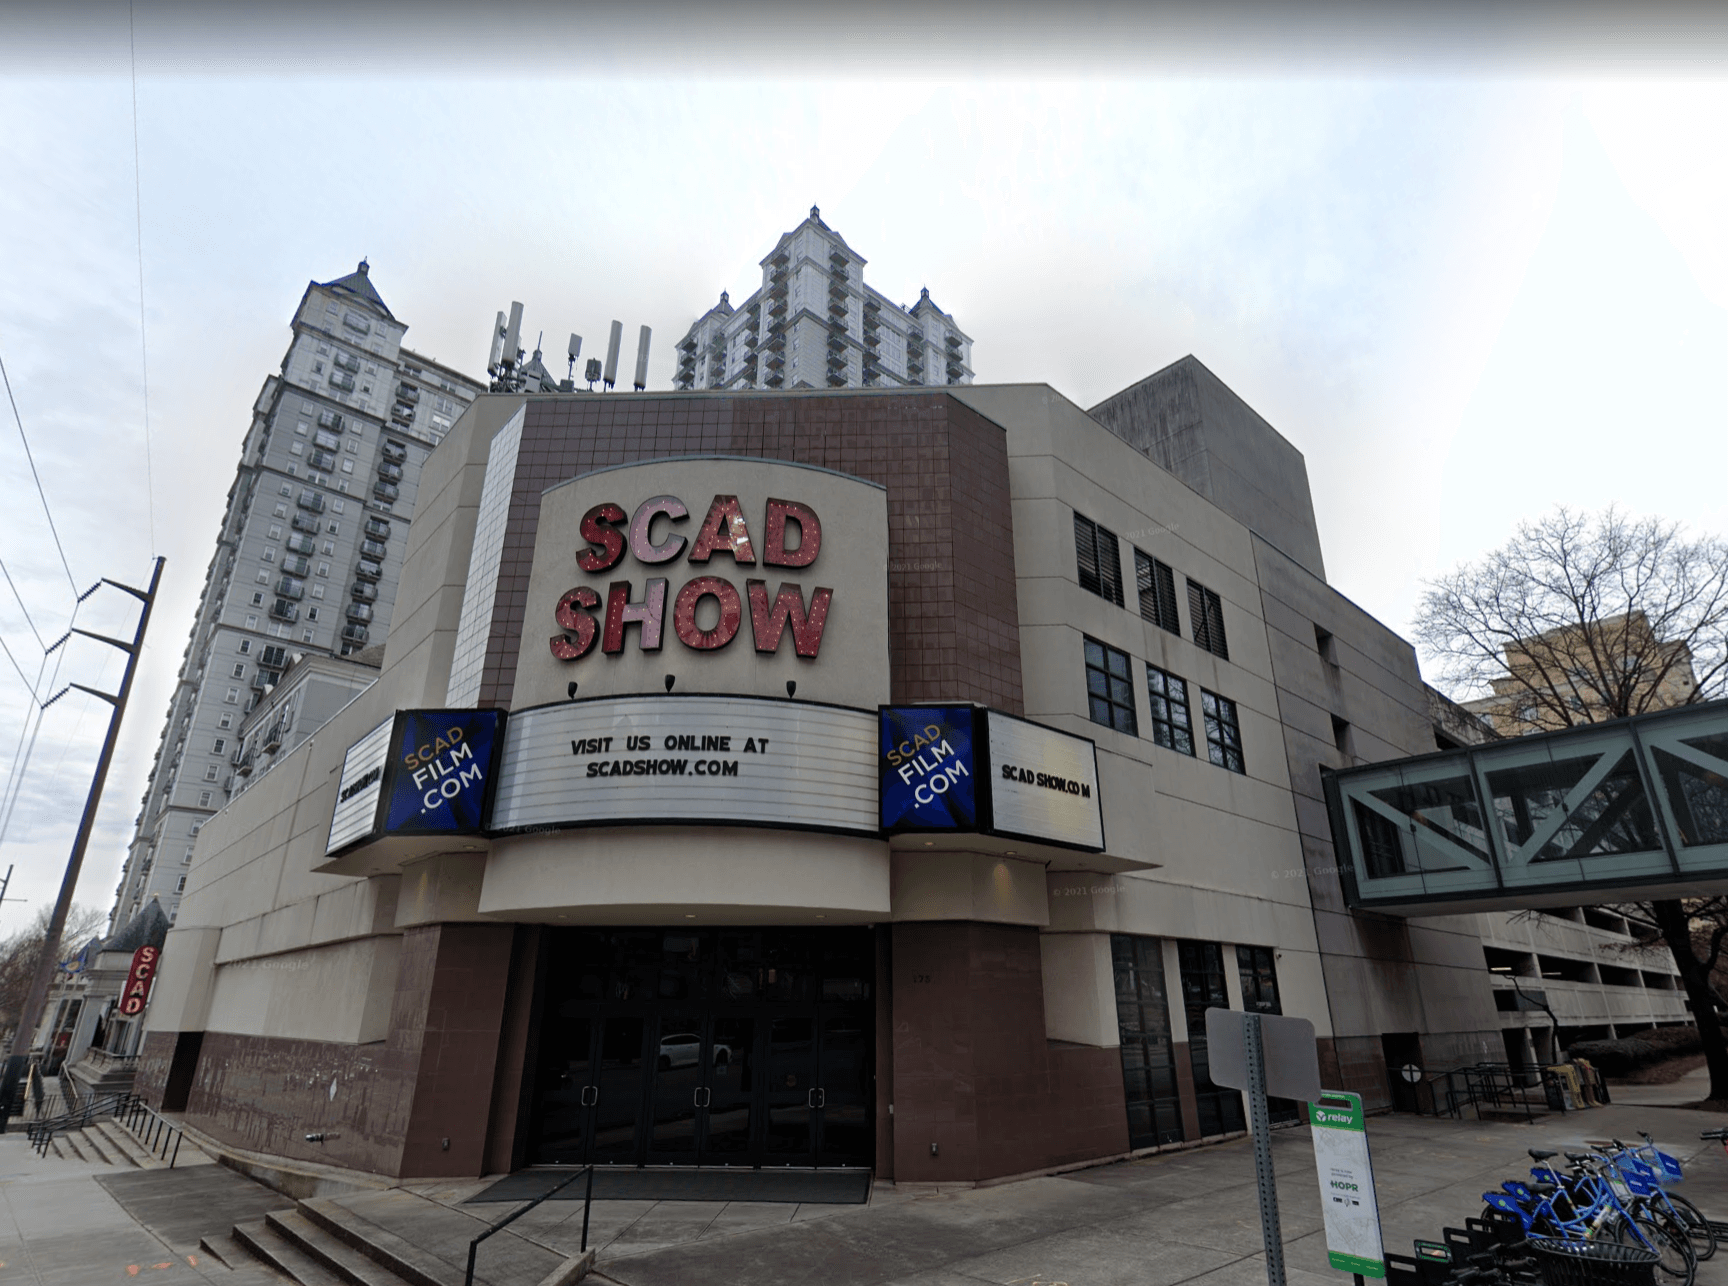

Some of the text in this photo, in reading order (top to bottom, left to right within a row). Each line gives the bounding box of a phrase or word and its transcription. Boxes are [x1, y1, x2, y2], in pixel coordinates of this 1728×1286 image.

[576, 495, 822, 573] SCAD
[550, 576, 833, 661] SHOW
[404, 726, 463, 770] SCAD
[412, 742, 473, 790] FILM
[571, 735, 769, 755] VISIT US ONLINE AT
[586, 759, 738, 777] SCADSHOW.COM
[886, 724, 941, 766] SCAD
[898, 739, 955, 785] FILM
[421, 763, 483, 814] .COM
[914, 759, 969, 809] .COM
[126, 946, 154, 1013] SCAD
[1327, 1113, 1353, 1125] relay
[1330, 1180, 1359, 1192] HOPR
